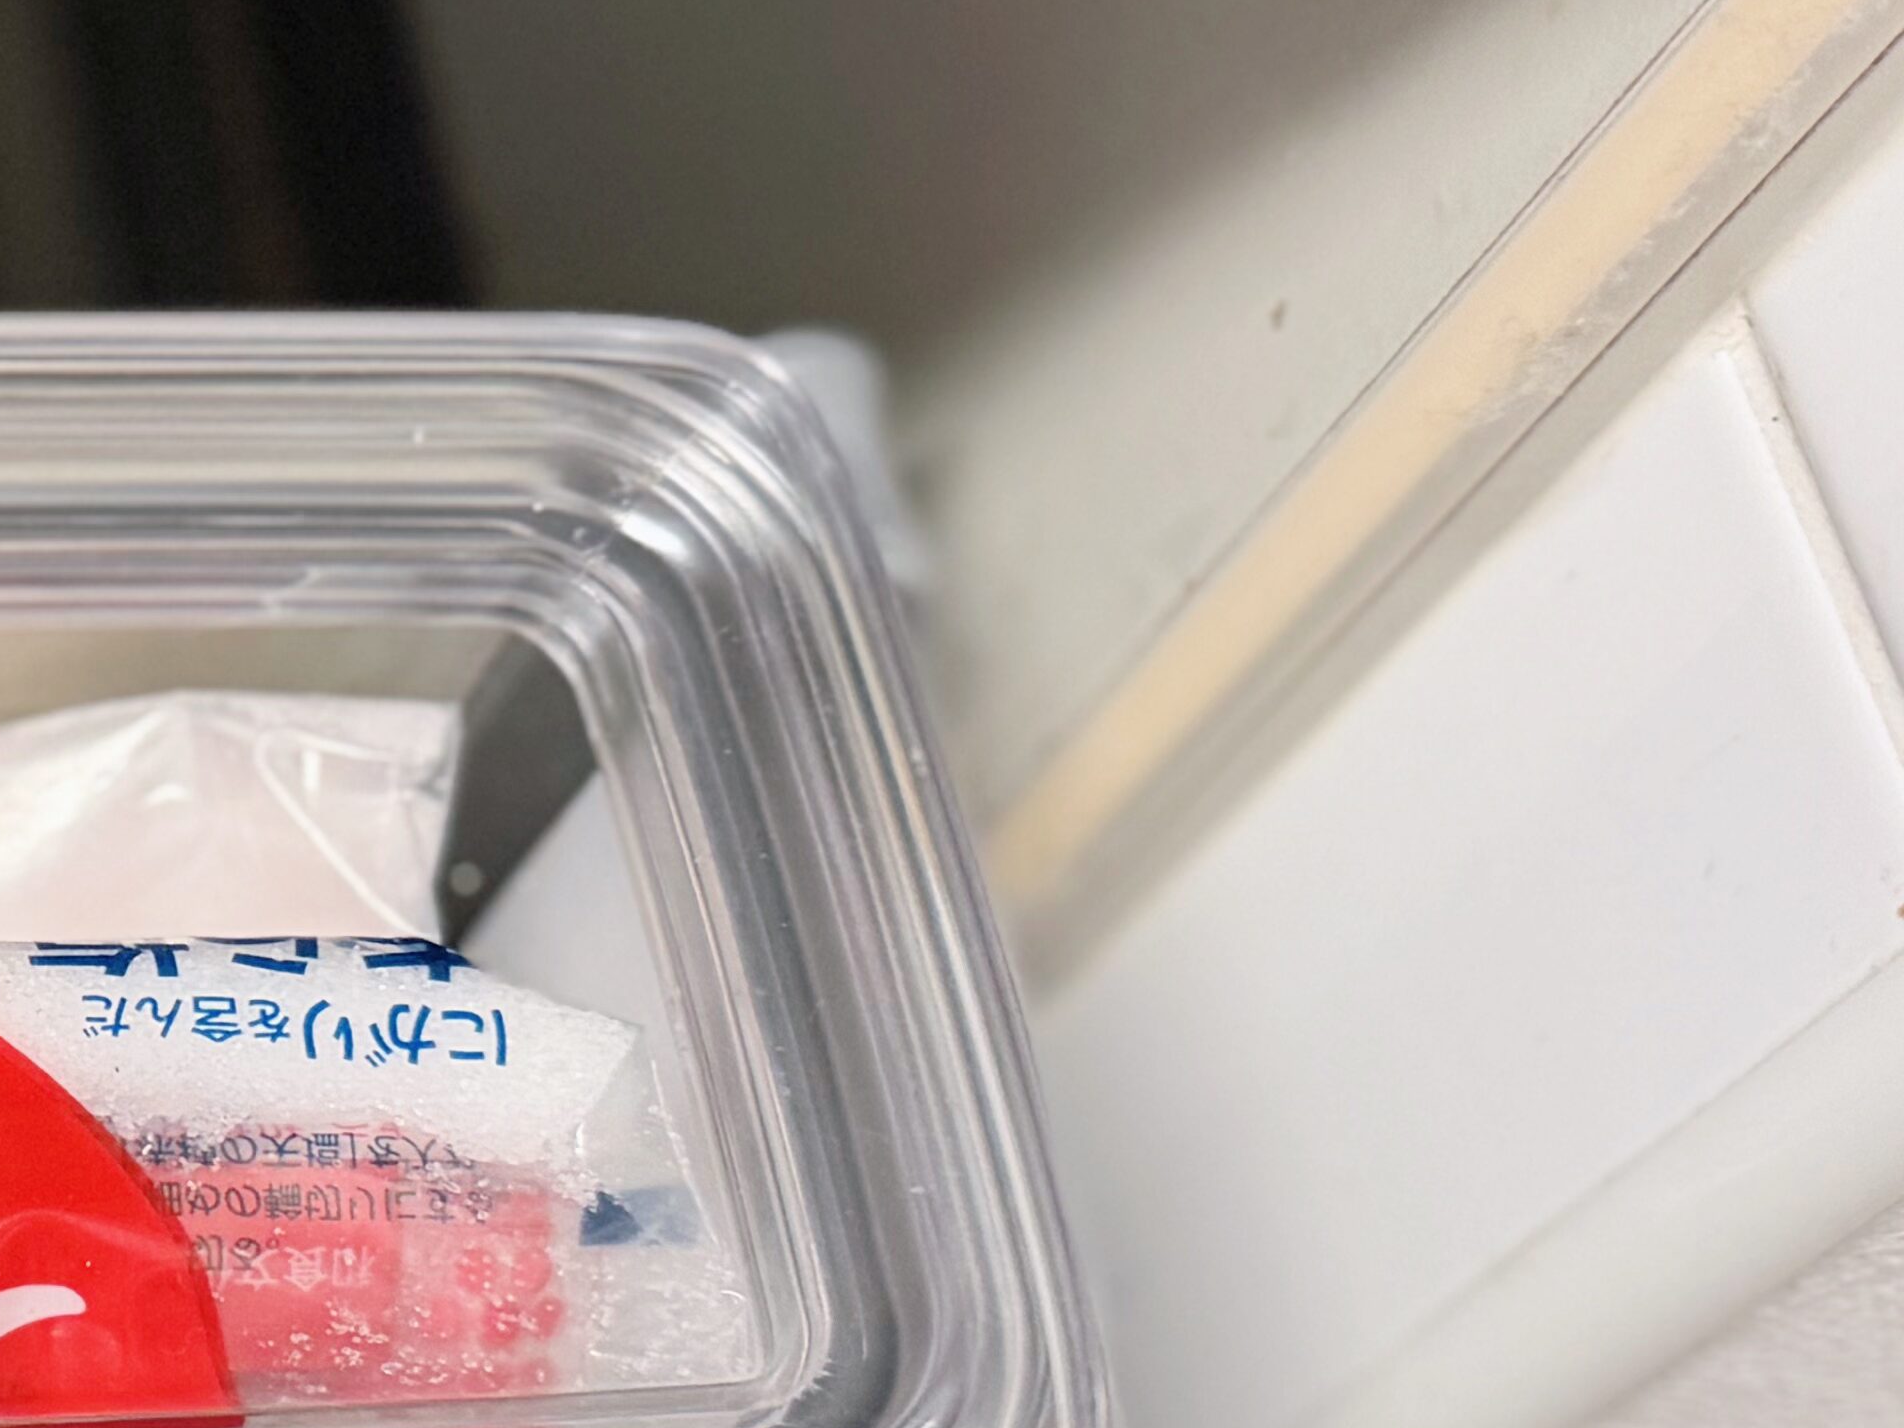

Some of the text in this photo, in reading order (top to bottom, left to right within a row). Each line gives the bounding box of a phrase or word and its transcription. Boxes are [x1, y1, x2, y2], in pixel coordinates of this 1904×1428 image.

[79, 992, 509, 1069] にがりを含んだ
